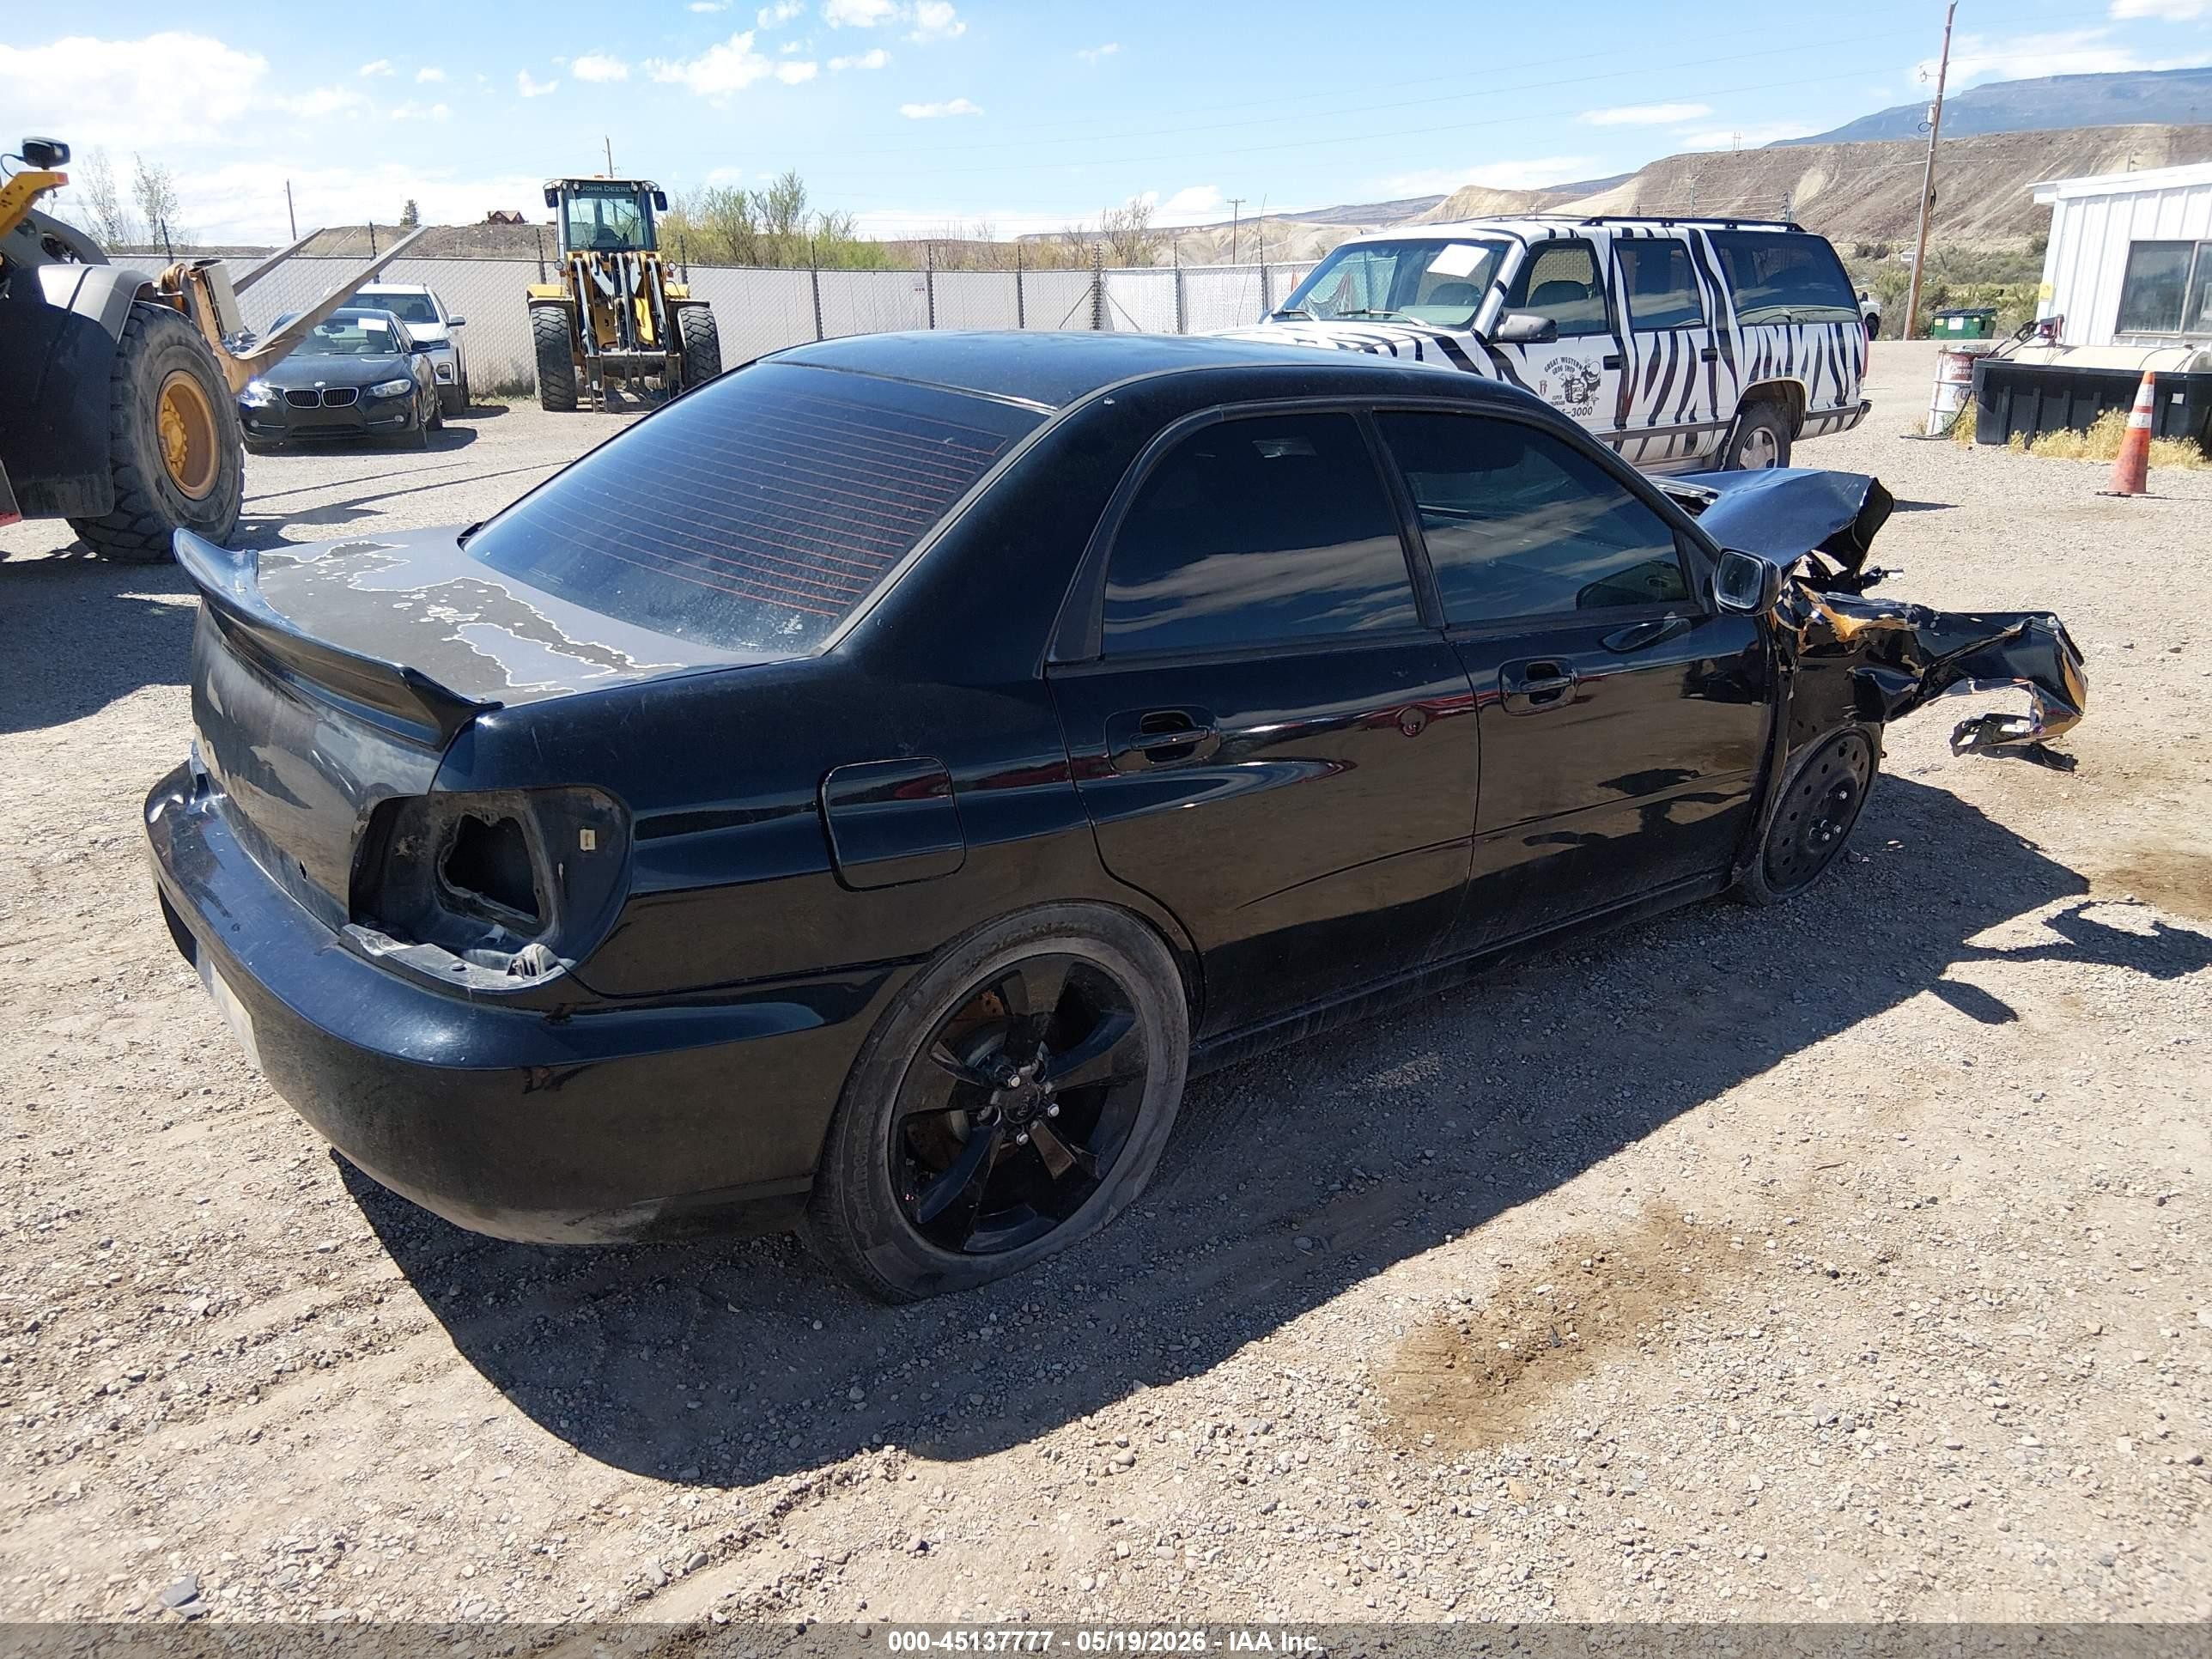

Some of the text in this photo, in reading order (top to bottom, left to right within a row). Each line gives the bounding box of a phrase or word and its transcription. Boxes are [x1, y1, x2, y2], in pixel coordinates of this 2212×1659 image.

[604, 185, 631, 193] DEERE
[1544, 356, 1583, 373] GREAT WESTERN
[1552, 365, 1576, 375] GROG SHOP
